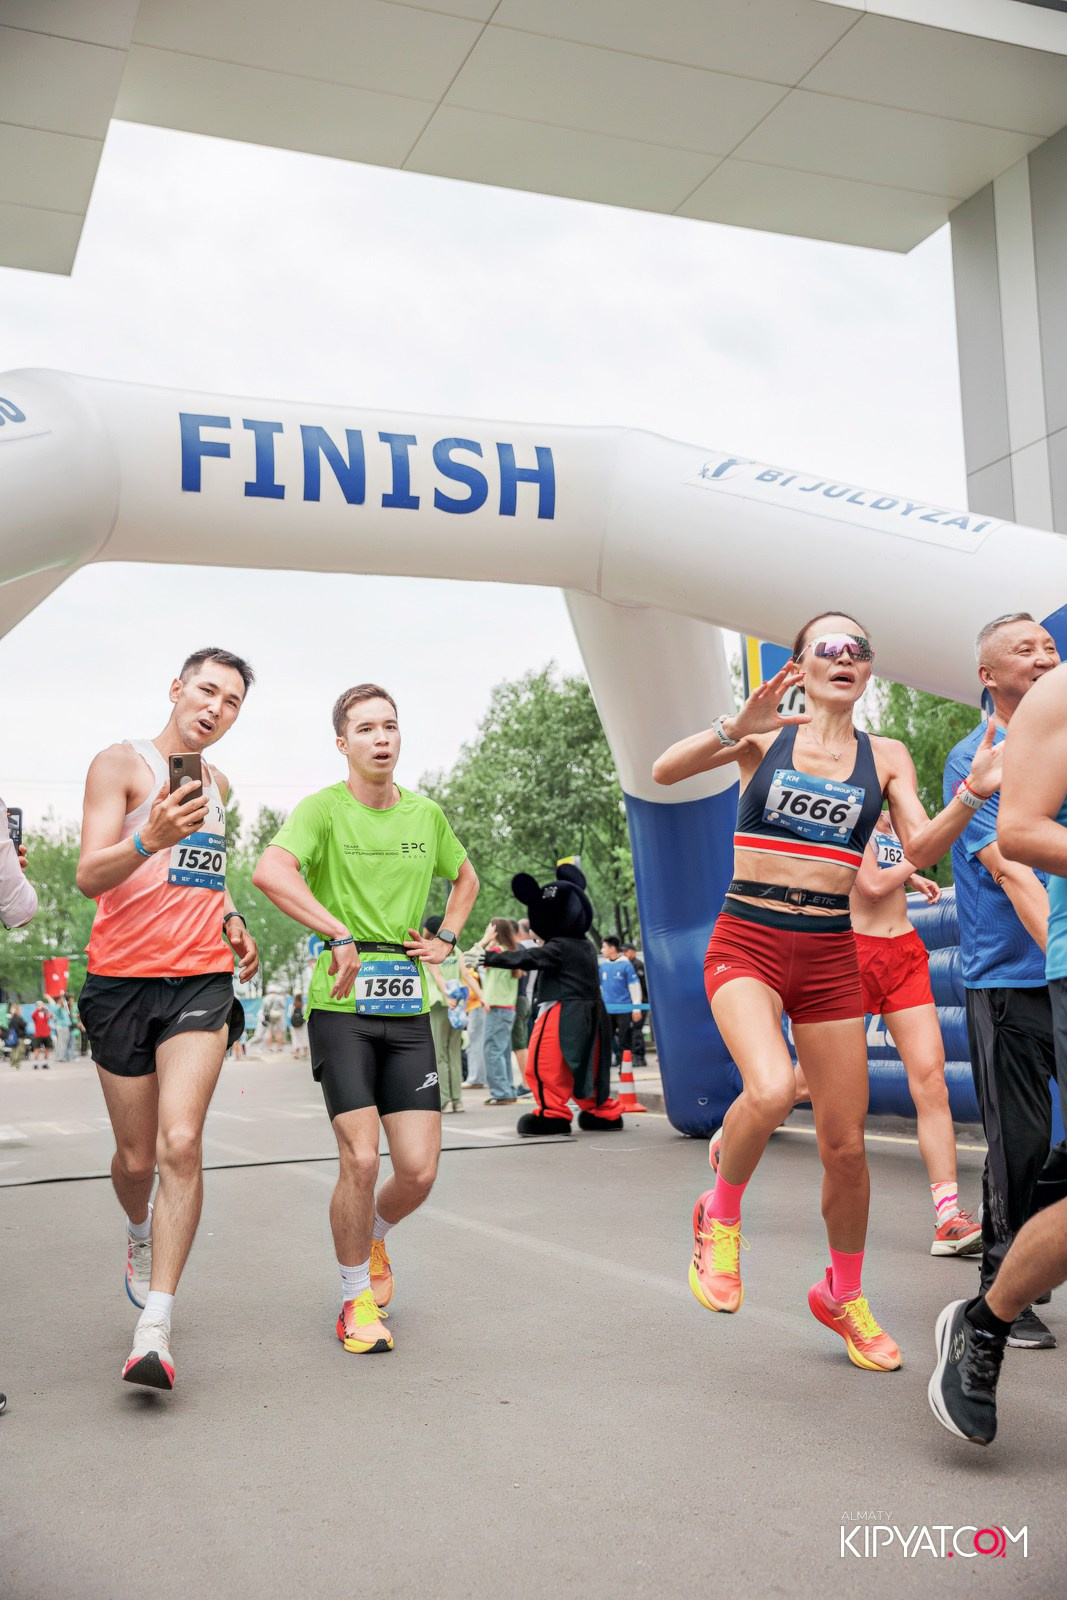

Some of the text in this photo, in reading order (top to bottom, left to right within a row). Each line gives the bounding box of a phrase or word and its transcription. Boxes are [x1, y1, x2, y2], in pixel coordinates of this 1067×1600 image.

[179, 412, 556, 520] FINISH
[755, 469, 992, 533] BI JULDYZAI
[786, 774, 799, 783] KM
[777, 790, 851, 824] 1666
[178, 848, 222, 872] 1520
[884, 847, 905, 863] 162
[364, 978, 415, 997] 1366
